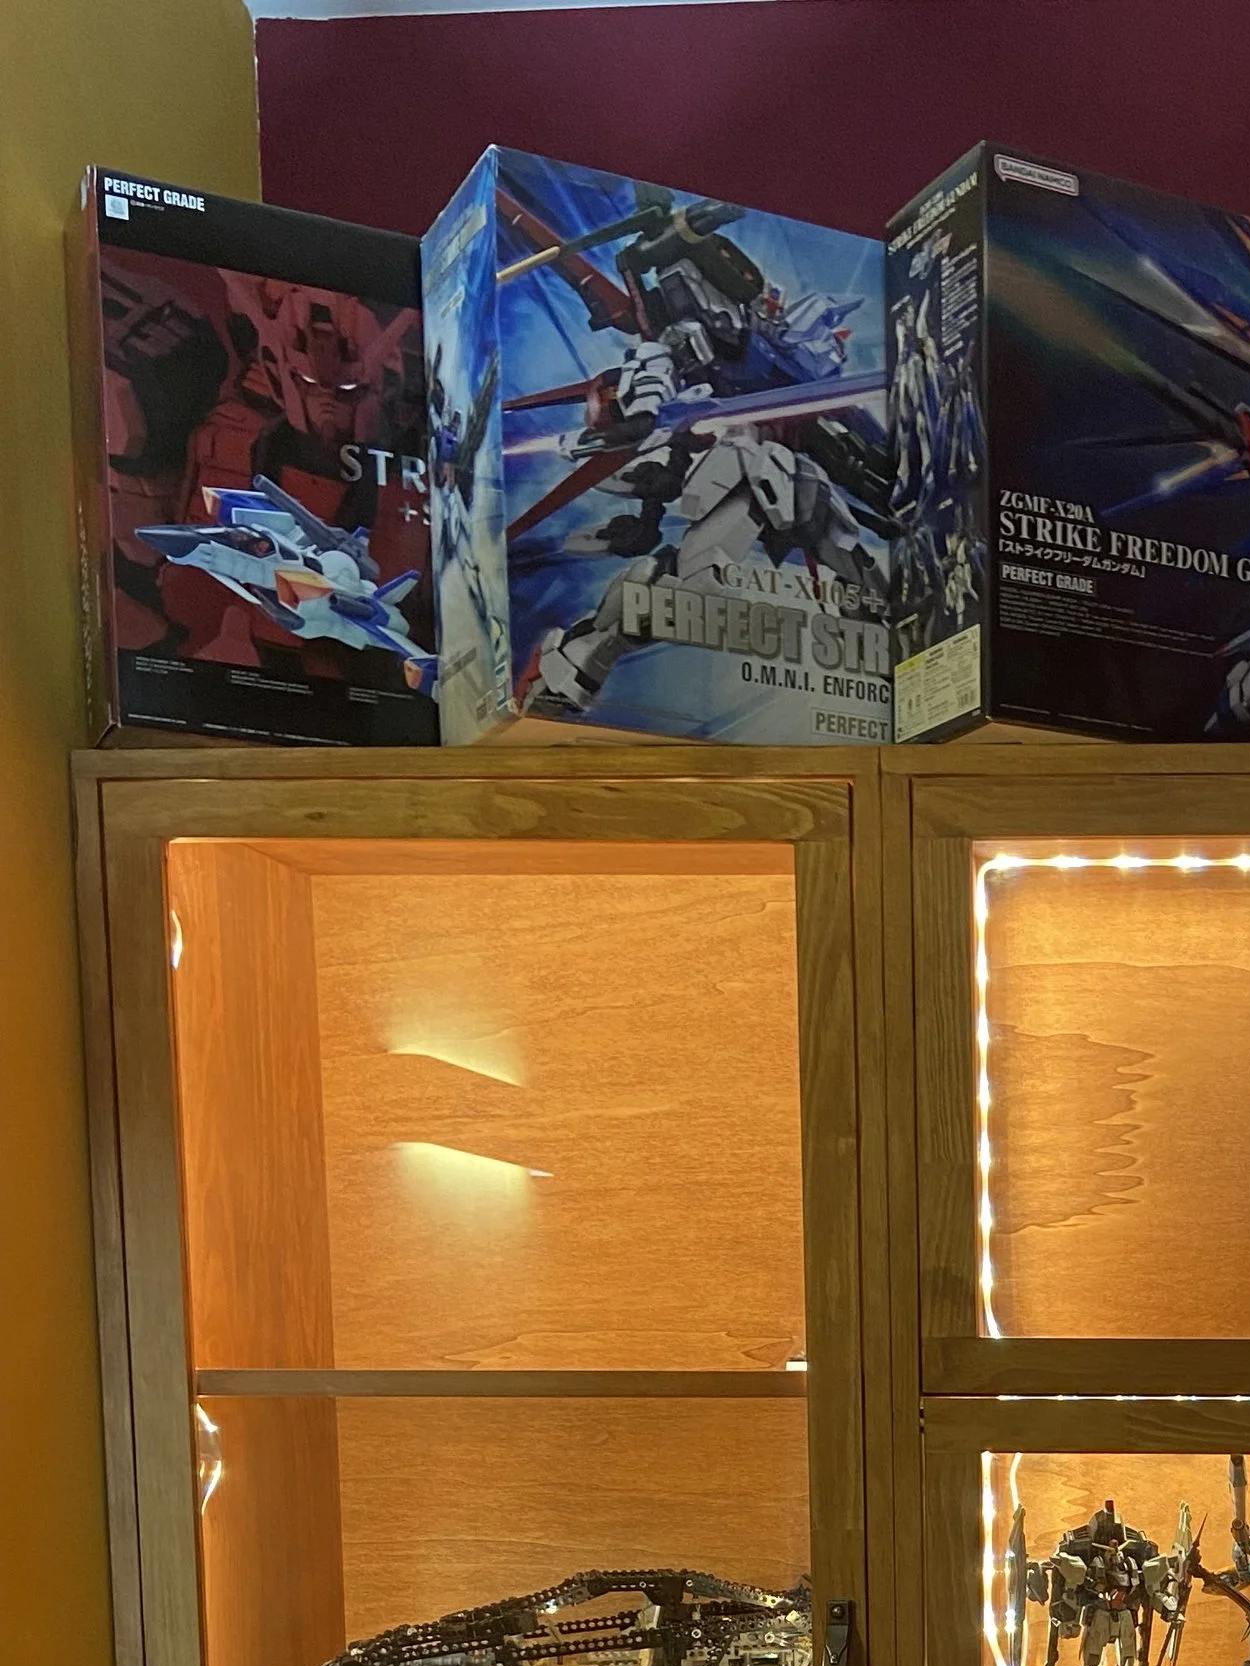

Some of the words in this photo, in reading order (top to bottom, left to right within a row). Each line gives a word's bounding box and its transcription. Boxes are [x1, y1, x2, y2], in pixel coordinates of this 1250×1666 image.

[1001, 161, 1036, 178] BANDAI
[1037, 172, 1072, 188] NAMCO
[103, 176, 161, 202] PERFECT
[162, 189, 206, 213] GRADE
[339, 443, 427, 494] STR
[999, 489, 1096, 524] ZGMF-X20A
[999, 510, 1102, 553] STRIKE
[1110, 530, 1229, 579] FREEDOM
[1001, 565, 1054, 590] PERFECT
[1055, 573, 1094, 594] GRADE
[621, 581, 808, 665] PERFECT
[811, 613, 891, 679] STR
[741, 661, 815, 693] O.M.N.I.
[823, 675, 890, 704] ENFORC
[814, 711, 889, 741] PERFECT
